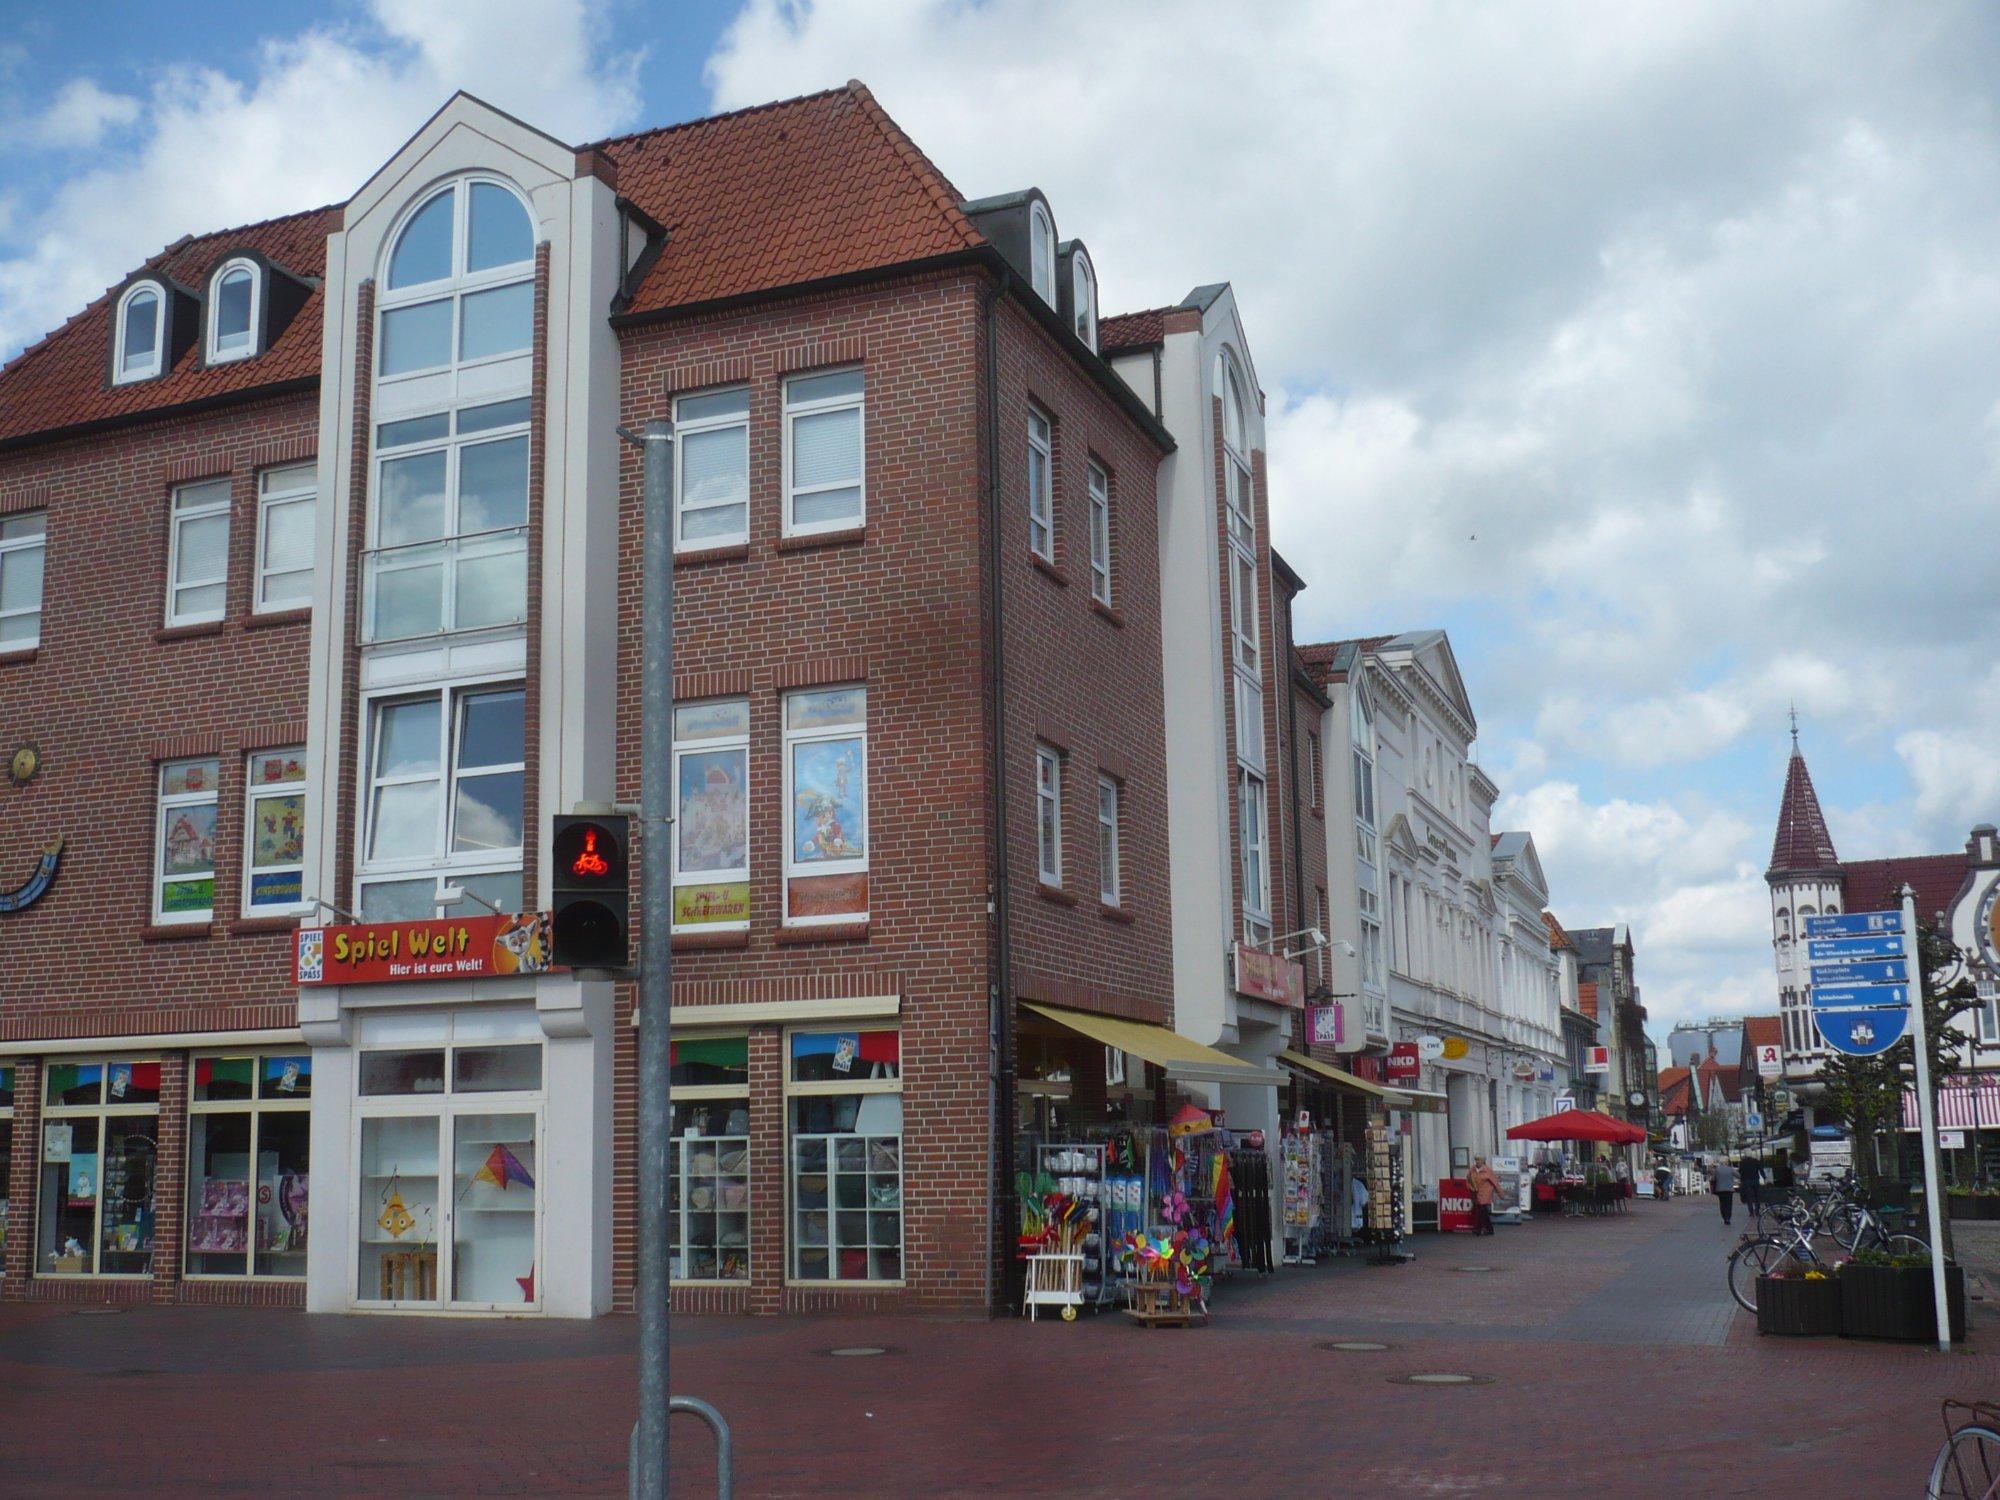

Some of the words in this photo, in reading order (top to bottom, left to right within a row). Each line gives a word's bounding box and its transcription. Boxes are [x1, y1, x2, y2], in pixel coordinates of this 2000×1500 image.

[300, 932, 322, 943] SPIEL
[334, 929, 400, 967] Spiel
[408, 926, 469, 956] Welt
[389, 963, 412, 976] Hier
[413, 962, 427, 974] ist
[429, 962, 454, 973] eure
[456, 958, 483, 971] Welt!
[299, 970, 321, 980] SPASS
[1387, 1056, 1415, 1066] NKD
[1441, 1197, 1474, 1211] NKD
